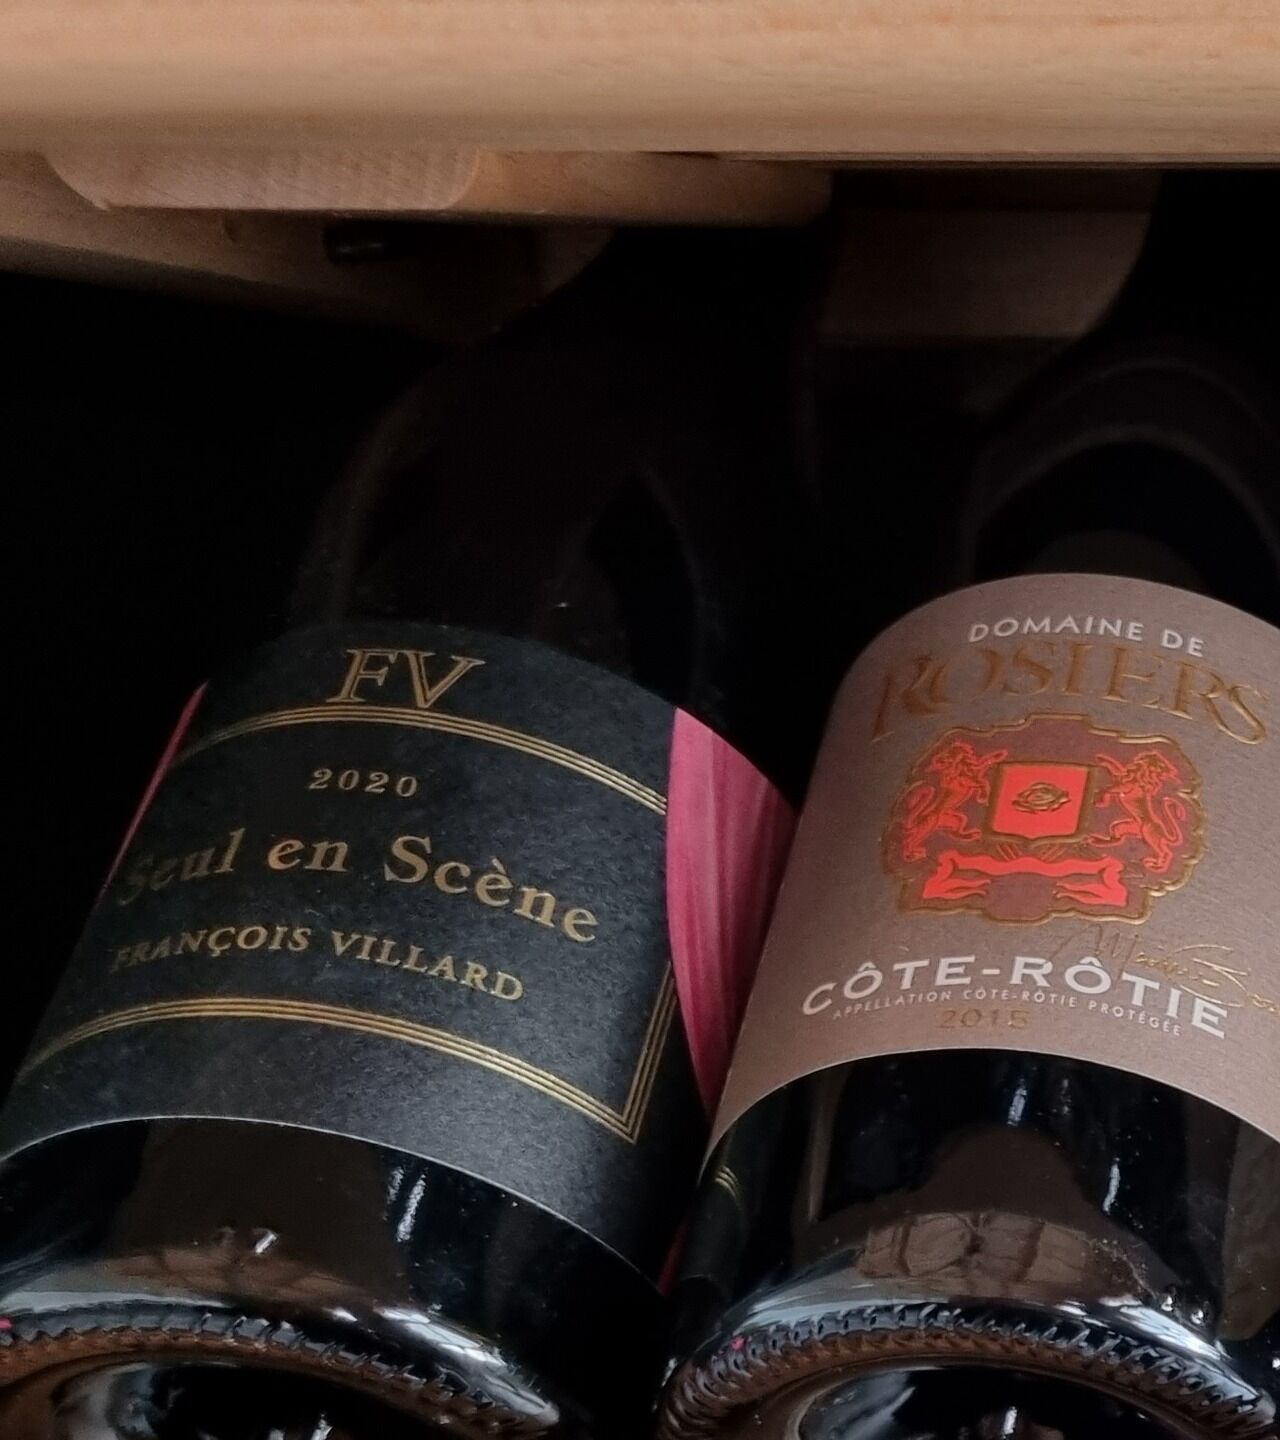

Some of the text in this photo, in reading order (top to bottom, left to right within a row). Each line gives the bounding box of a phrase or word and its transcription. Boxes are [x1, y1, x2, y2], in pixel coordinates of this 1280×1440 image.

[967, 614, 1205, 658] DOMAINE DE
[326, 647, 486, 709] FV
[870, 637, 1269, 746] ROSIERS
[308, 767, 419, 799] 2020
[267, 837, 349, 873] en
[384, 833, 600, 945] Scène
[110, 925, 525, 1002] FRANÇOIS VILLARD
[802, 954, 1229, 1041] CÔTE-RÔTIE
[832, 984, 1184, 1038] APPELLATION CÔTE-RÔTIE PROTÉGÉE
